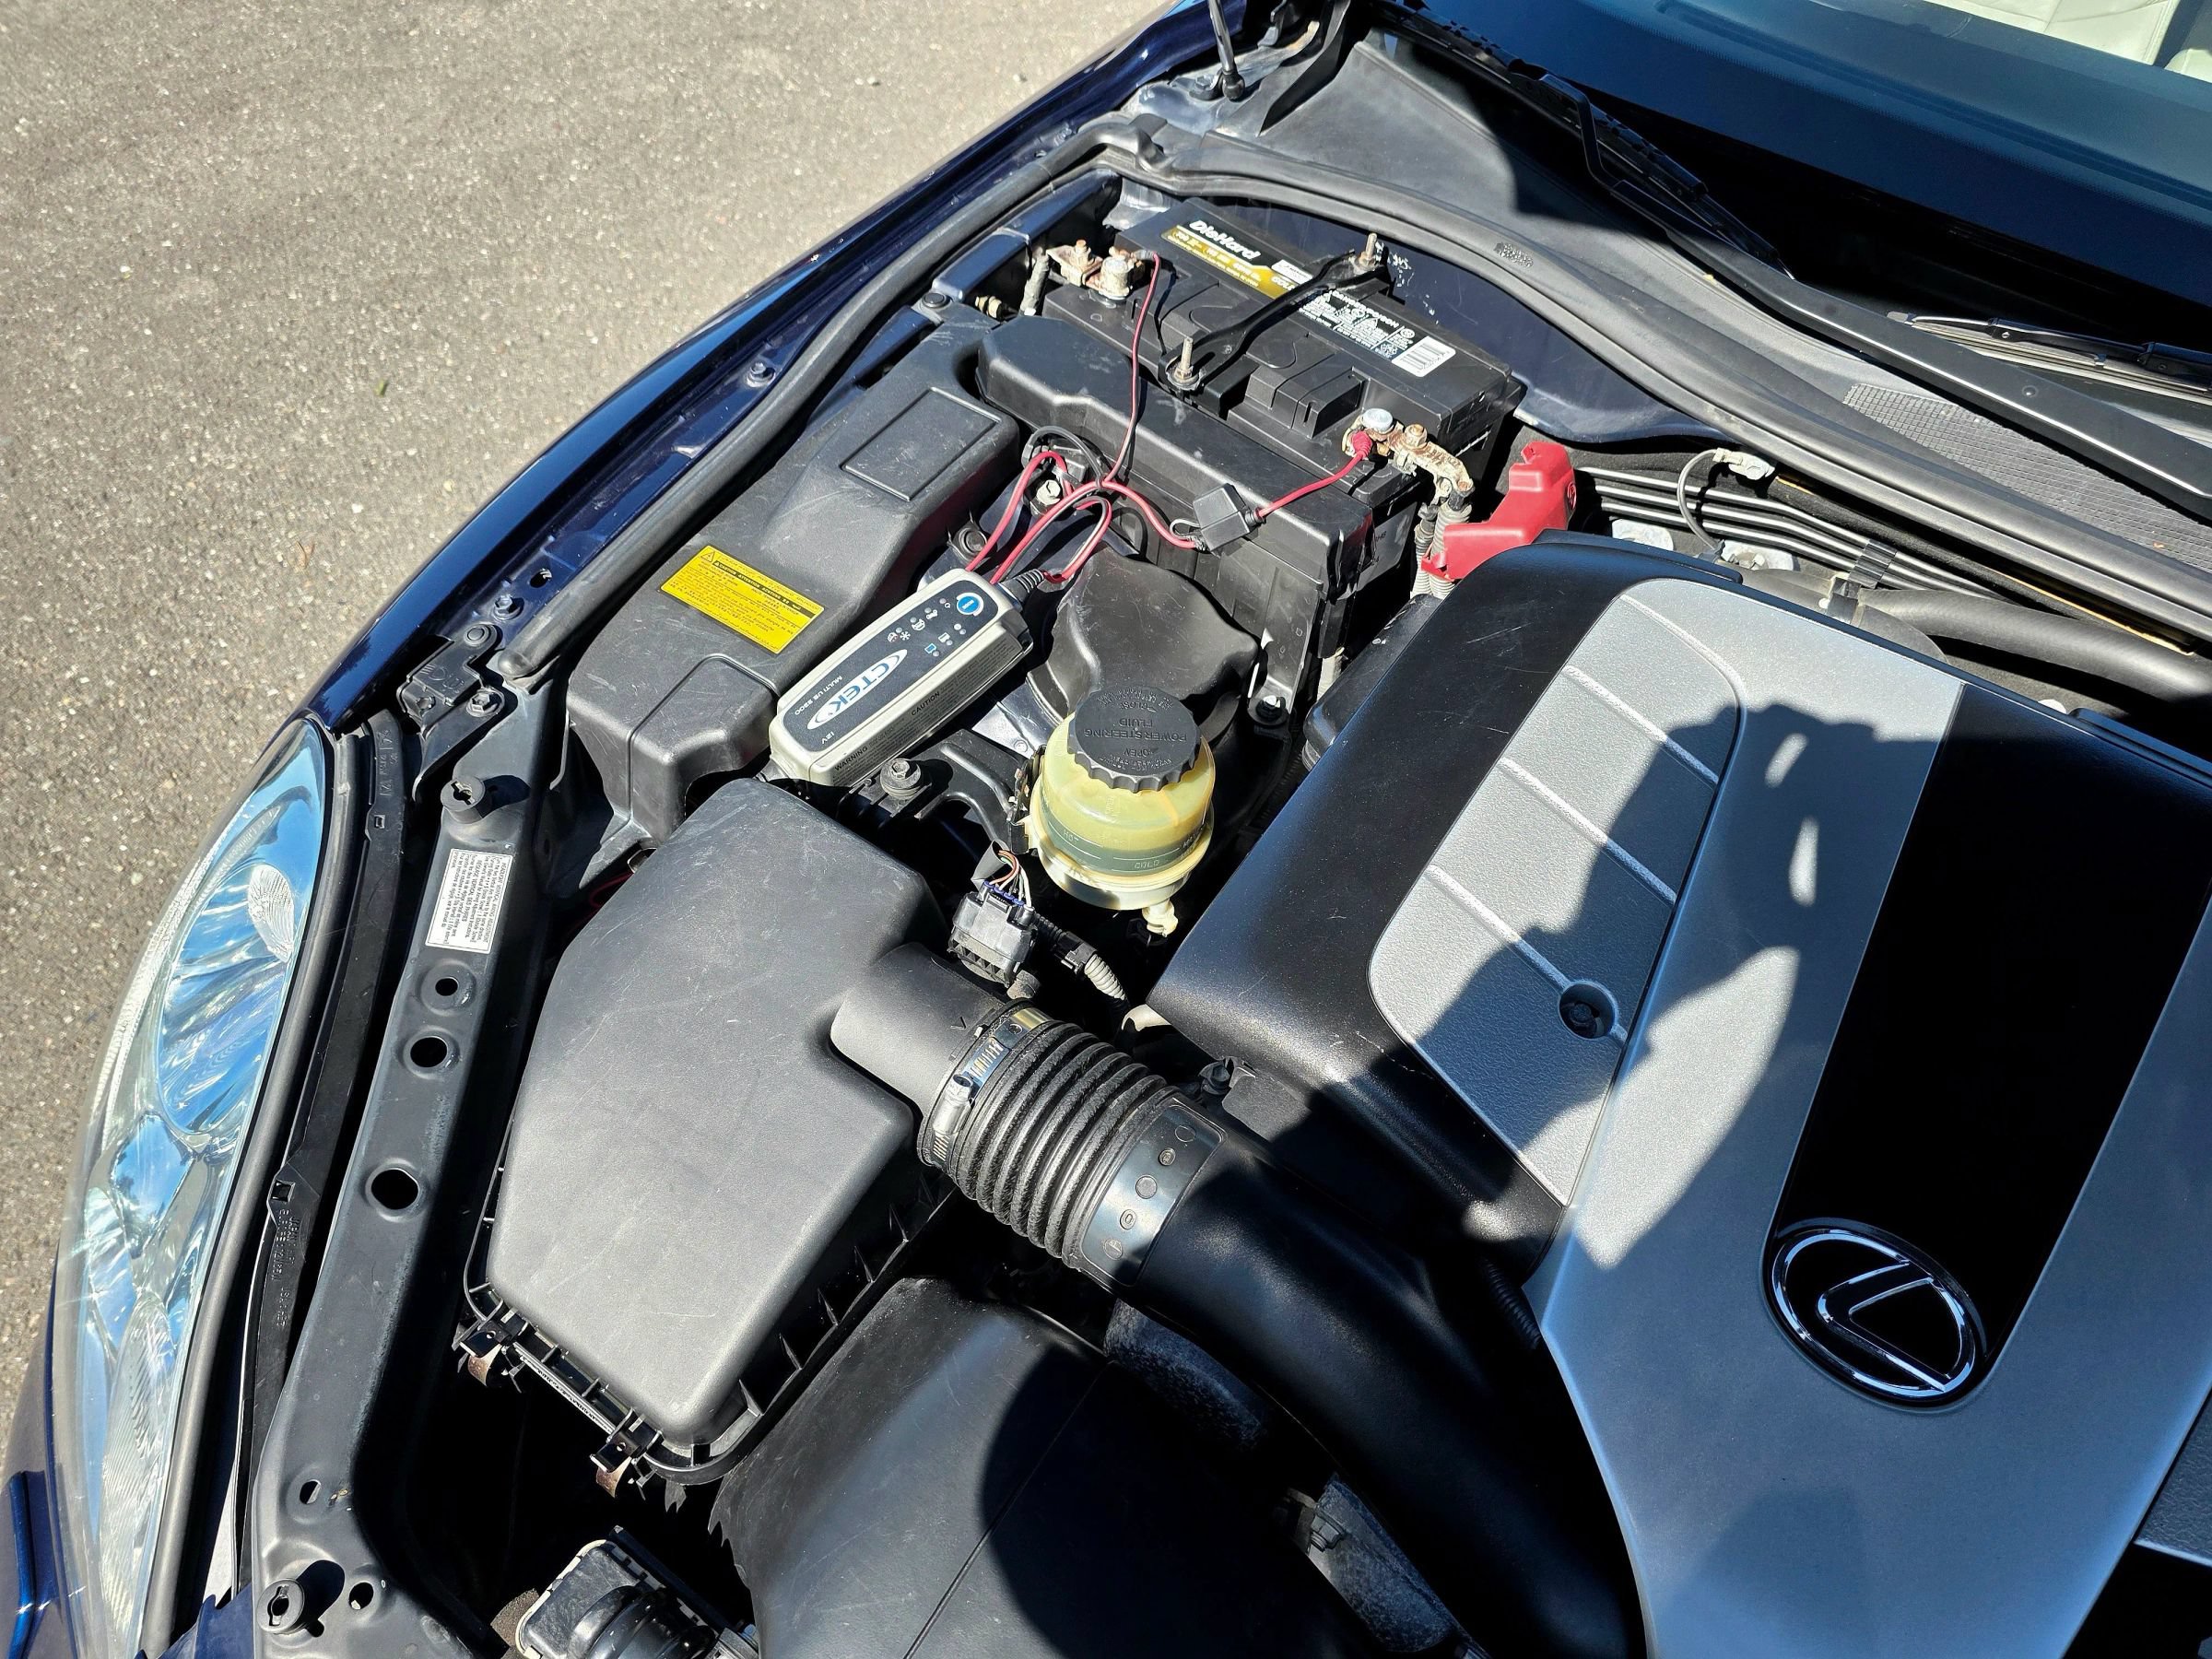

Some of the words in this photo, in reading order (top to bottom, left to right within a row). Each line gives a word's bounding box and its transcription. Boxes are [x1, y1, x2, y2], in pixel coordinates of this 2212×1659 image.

[1188, 218, 1261, 260] DieHard
[822, 675, 842, 692] MULTI
[828, 660, 890, 712] CTEK
[910, 690, 940, 715] CAUTION
[1119, 717, 1152, 727] FLUID
[822, 730, 834, 745] 12V
[1083, 728, 1141, 738] STEERING
[1144, 731, 1186, 741] POWER
[834, 745, 868, 770] WARNING
